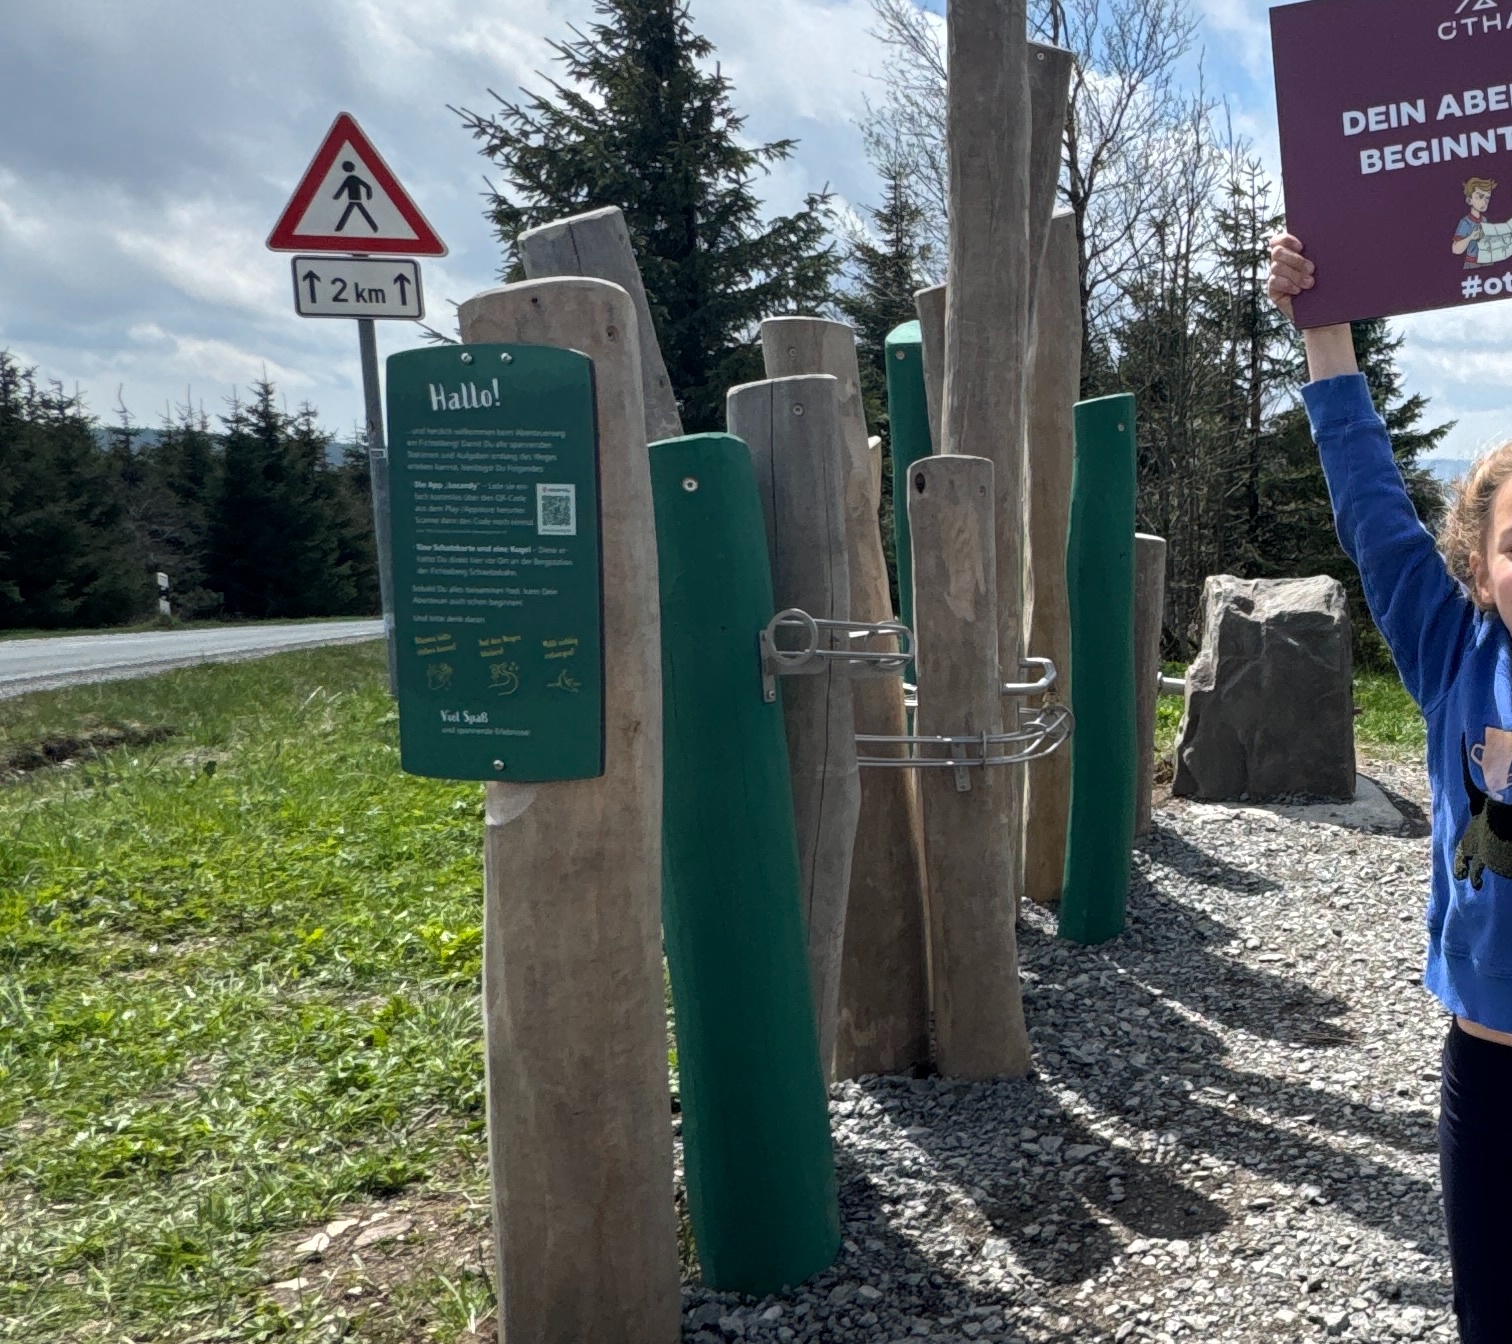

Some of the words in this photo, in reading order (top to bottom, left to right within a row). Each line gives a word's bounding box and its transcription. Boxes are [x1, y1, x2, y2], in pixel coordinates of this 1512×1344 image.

[1341, 99, 1426, 137] DEIN
[331, 277, 348, 303] 2
[354, 282, 387, 304] km
[428, 377, 501, 411] Hallo!
